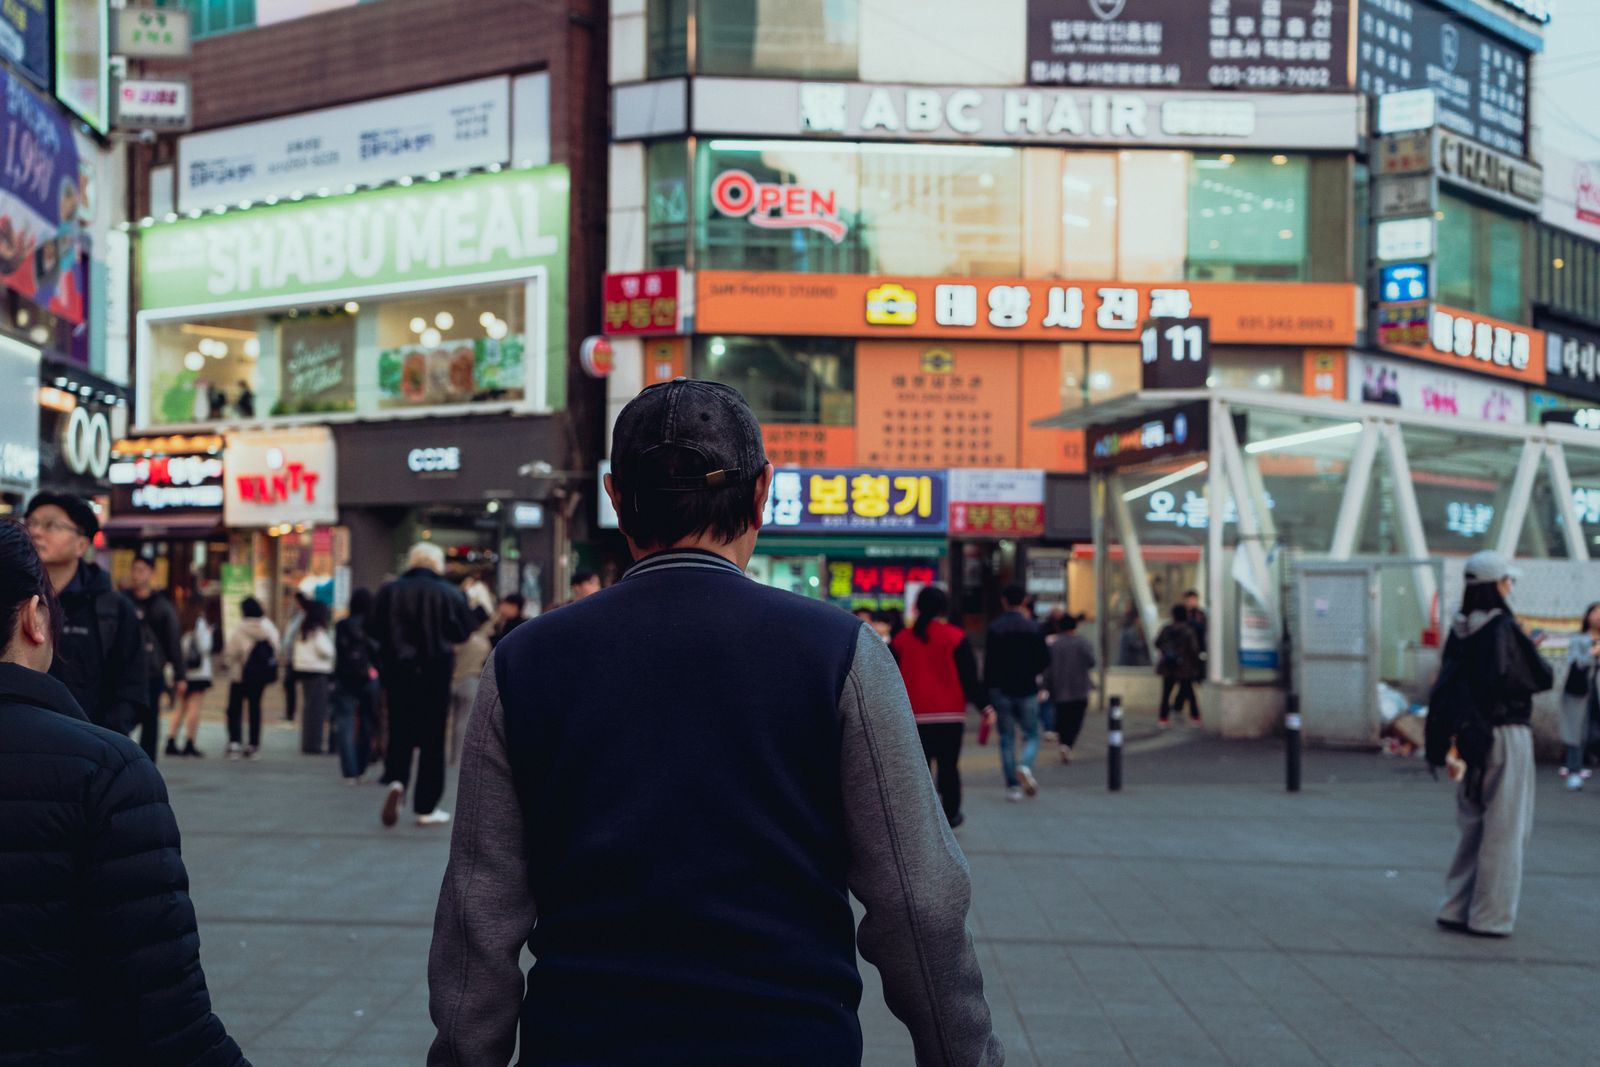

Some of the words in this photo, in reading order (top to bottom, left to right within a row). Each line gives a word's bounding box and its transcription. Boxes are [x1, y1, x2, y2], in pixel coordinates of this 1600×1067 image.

[860, 86, 984, 133] ABC
[1004, 90, 1146, 137] HAIR
[711, 169, 837, 217] OPEN
[207, 203, 385, 295] SHABU
[394, 183, 558, 274] MEAL
[1164, 325, 1202, 361] 11
[808, 474, 932, 518] 보청기
